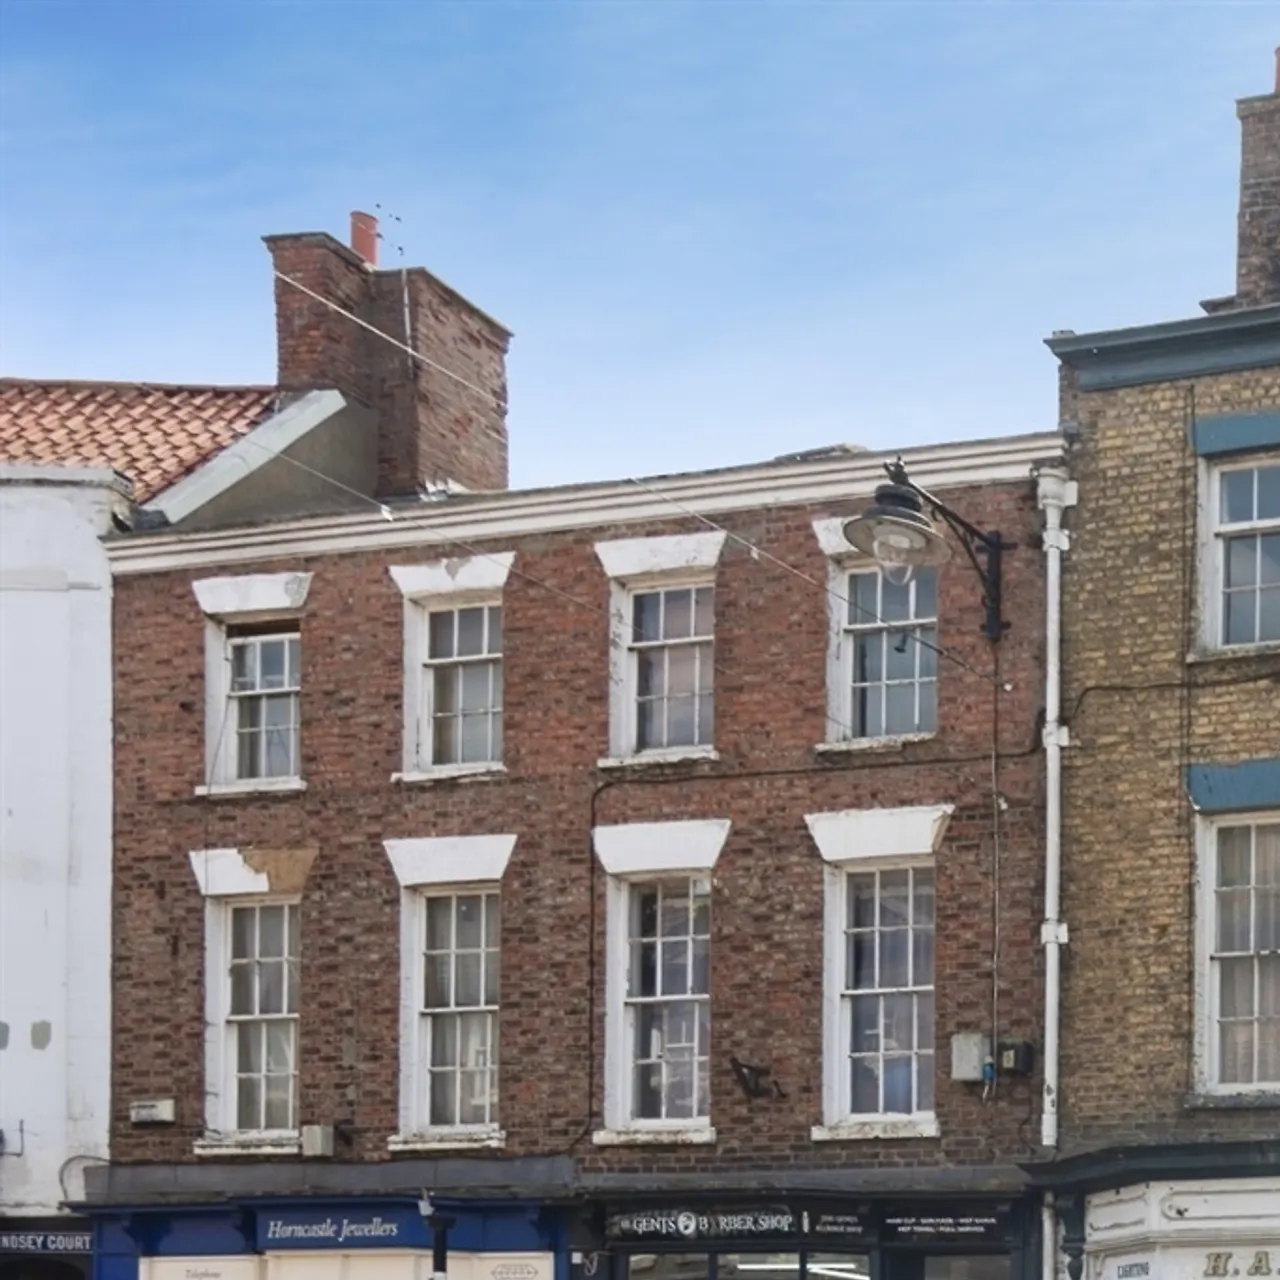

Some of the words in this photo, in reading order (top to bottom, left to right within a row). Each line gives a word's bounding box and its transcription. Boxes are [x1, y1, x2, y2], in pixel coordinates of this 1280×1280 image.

[267, 1219, 338, 1240] Horncastle
[338, 1217, 398, 1243] Jewellers
[633, 1216, 676, 1235] GENTS
[699, 1214, 756, 1235] BRBER
[757, 1214, 793, 1233] SHOP
[47, 1235, 92, 1250] COURT
